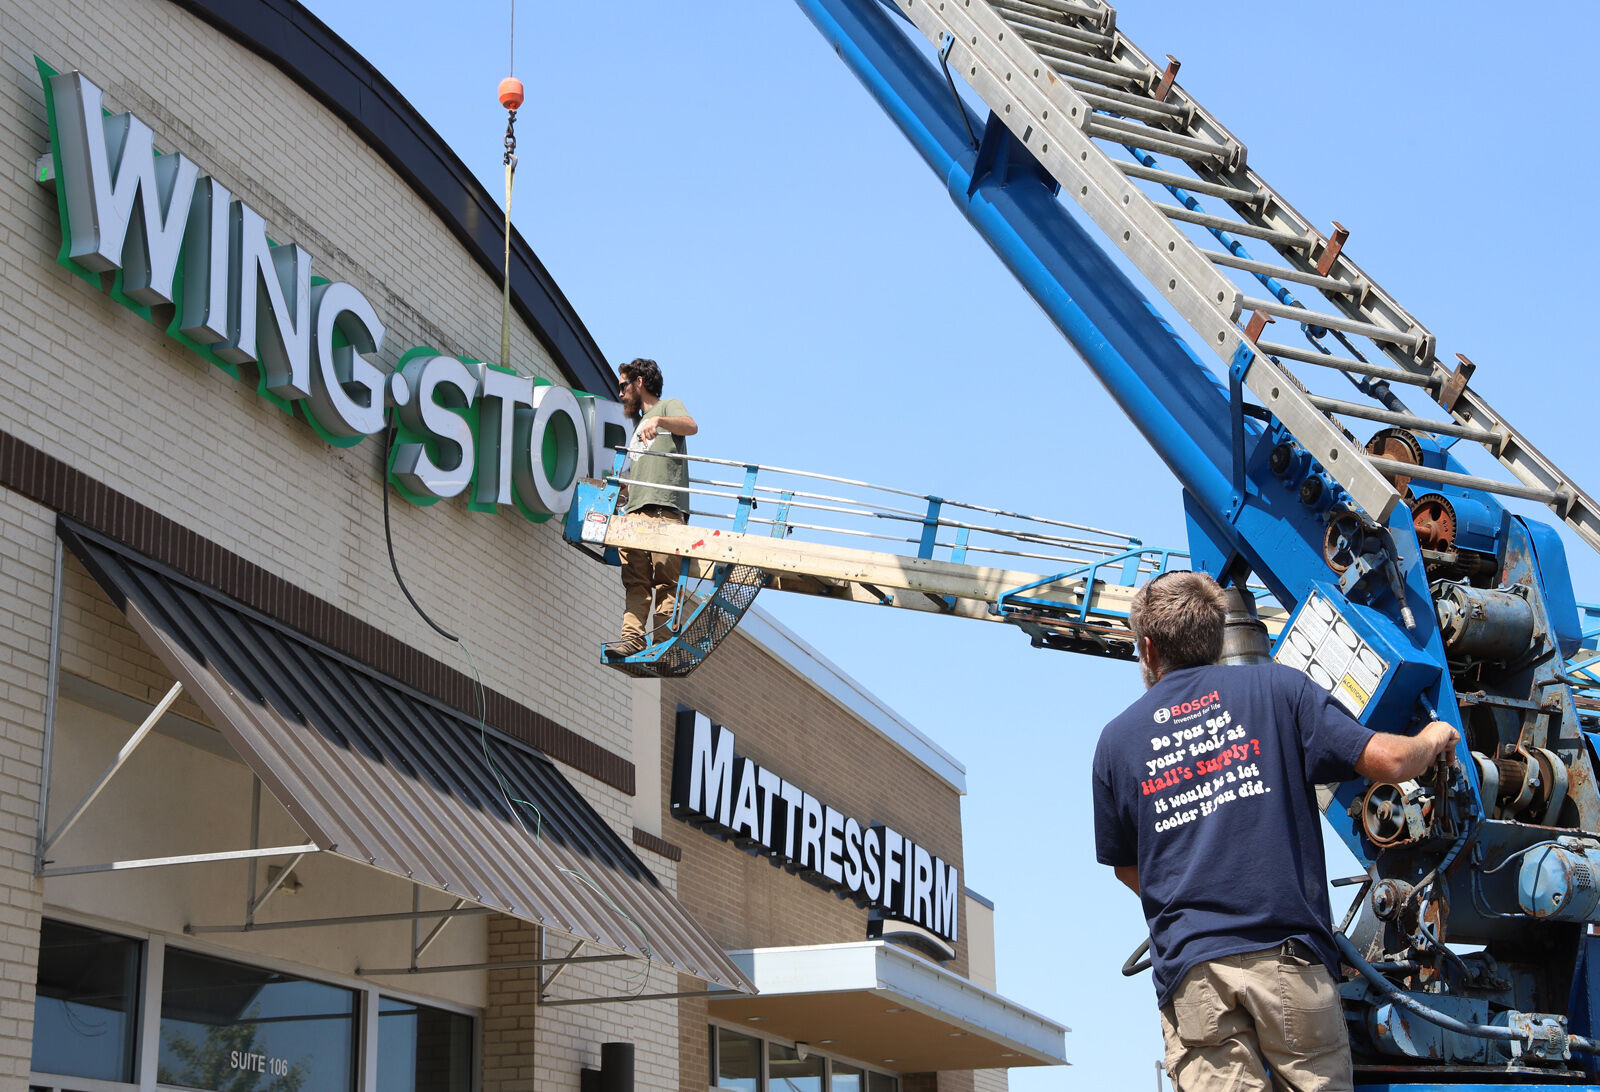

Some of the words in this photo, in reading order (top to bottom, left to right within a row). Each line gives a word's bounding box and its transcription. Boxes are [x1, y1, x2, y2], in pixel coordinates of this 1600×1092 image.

[1171, 690, 1220, 717] BOSCH
[1173, 711, 1202, 725] Invented
[1202, 706, 1210, 715] for
[1210, 703, 1221, 711] life
[1146, 748, 1187, 776] your
[1189, 733, 1225, 757] tools
[1226, 724, 1246, 740] at
[1151, 735, 1171, 751] Do
[1172, 724, 1205, 747] you
[1206, 710, 1232, 735] get
[1141, 766, 1193, 796] Hall's
[1168, 781, 1213, 810] would
[1225, 771, 1237, 783] a
[1237, 762, 1260, 780] lot
[688, 709, 881, 901] MATTRESS
[882, 825, 958, 942] FIRM
[1154, 807, 1199, 833] cooler
[1199, 801, 1213, 817] if
[1212, 789, 1237, 812] you
[1238, 780, 1271, 798] did.
[230, 1050, 266, 1073] SUITE
[269, 1057, 288, 1076] 106
